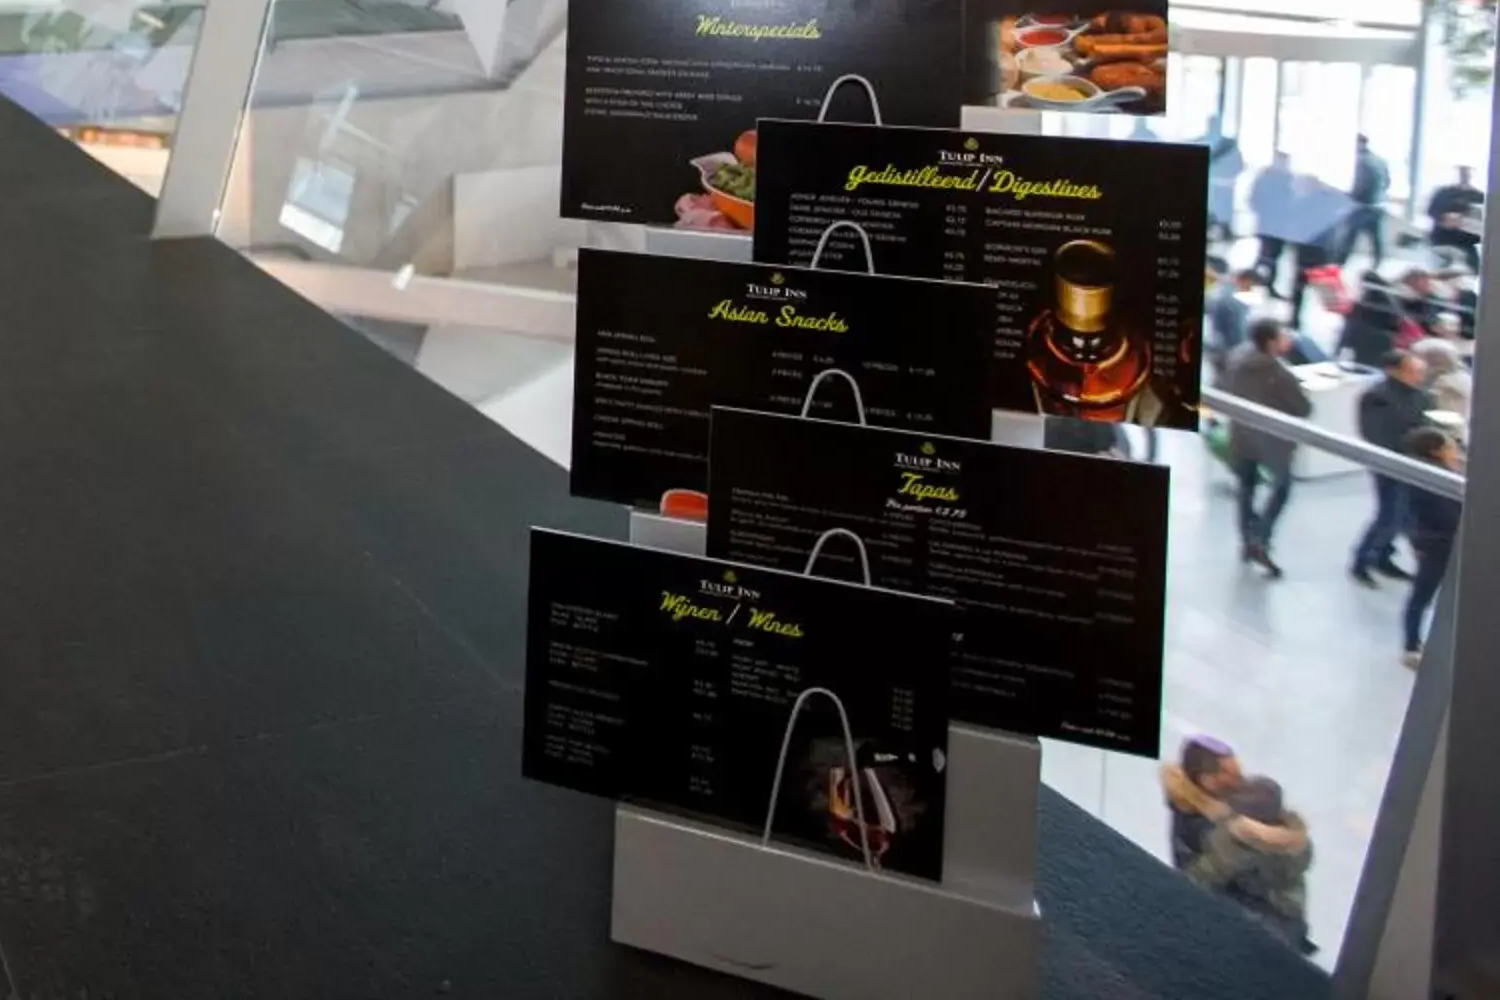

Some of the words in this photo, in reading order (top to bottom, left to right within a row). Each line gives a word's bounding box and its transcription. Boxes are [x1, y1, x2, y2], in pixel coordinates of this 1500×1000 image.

[708, 299, 769, 325] Asian
[775, 304, 849, 333] Snacks
[897, 471, 960, 501] Tapas
[660, 591, 722, 621] Wijnen
[748, 608, 804, 637] Wines
